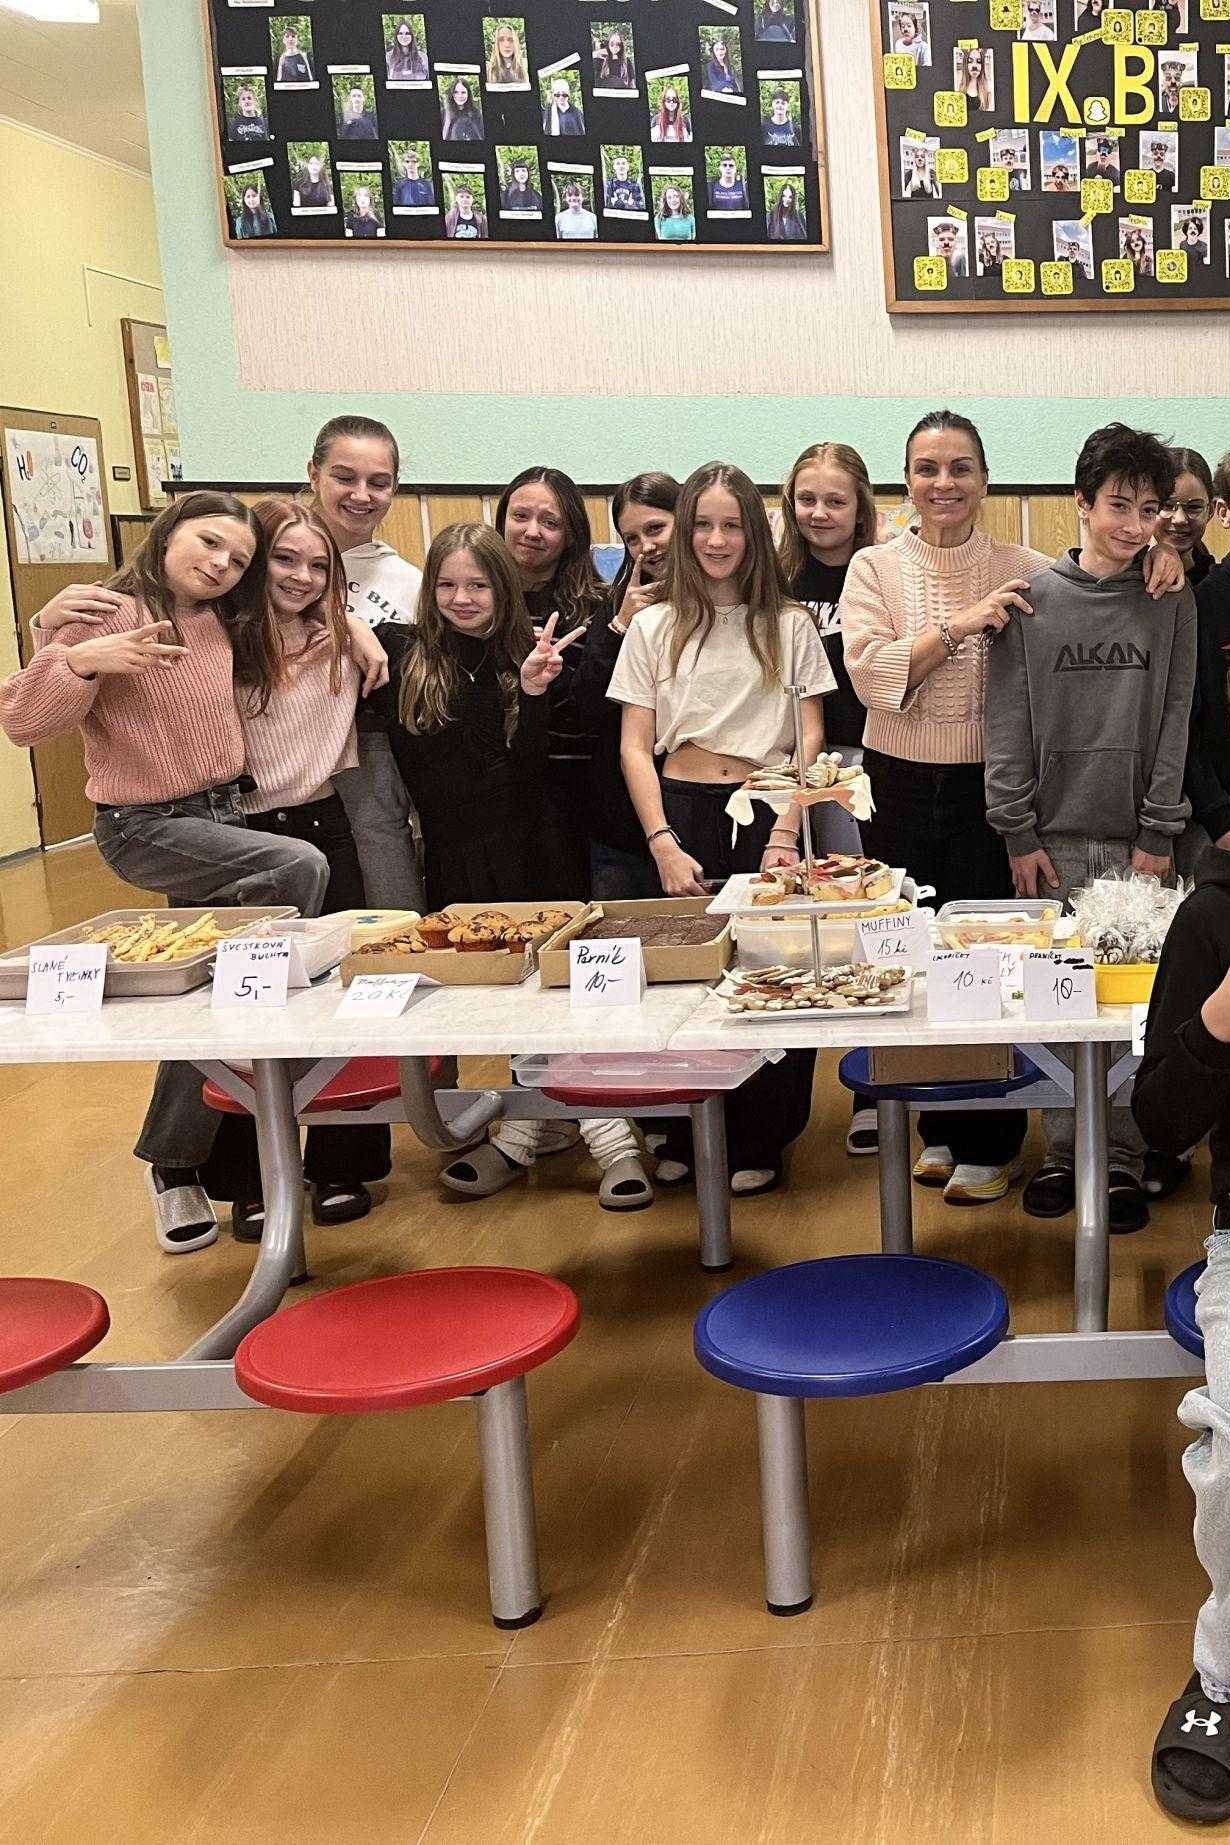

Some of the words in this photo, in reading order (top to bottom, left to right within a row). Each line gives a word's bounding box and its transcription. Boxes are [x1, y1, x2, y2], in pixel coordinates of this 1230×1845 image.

[1053, 642, 1151, 673] ALKAN
[861, 916, 911, 934] MUFFINY
[953, 971, 973, 990] 10
